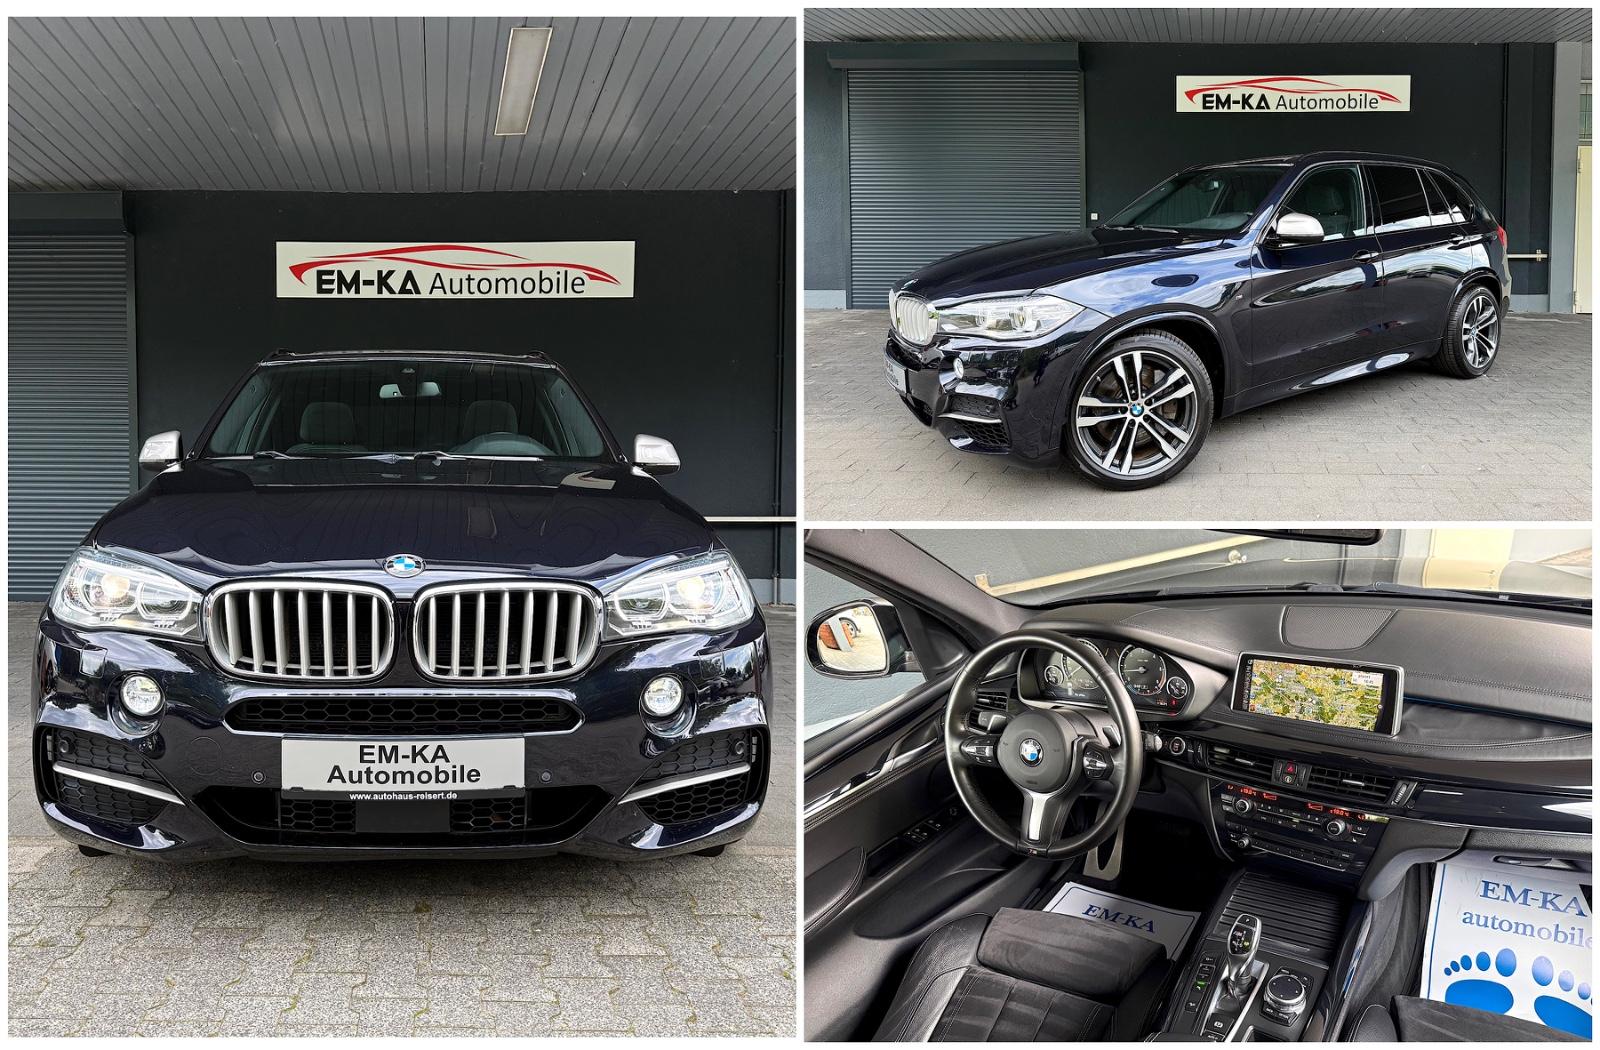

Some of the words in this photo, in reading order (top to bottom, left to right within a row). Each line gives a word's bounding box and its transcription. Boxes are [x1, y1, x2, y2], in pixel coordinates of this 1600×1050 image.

[1202, 93, 1271, 110] EM-KA
[1275, 93, 1379, 110] Automobile
[316, 269, 421, 294] EM-KA
[429, 270, 586, 295] Automobile
[359, 744, 450, 764] EM-KA
[326, 764, 481, 784] Automobile
[1479, 880, 1588, 918] EM-KA
[1081, 903, 1157, 934] EM-KA
